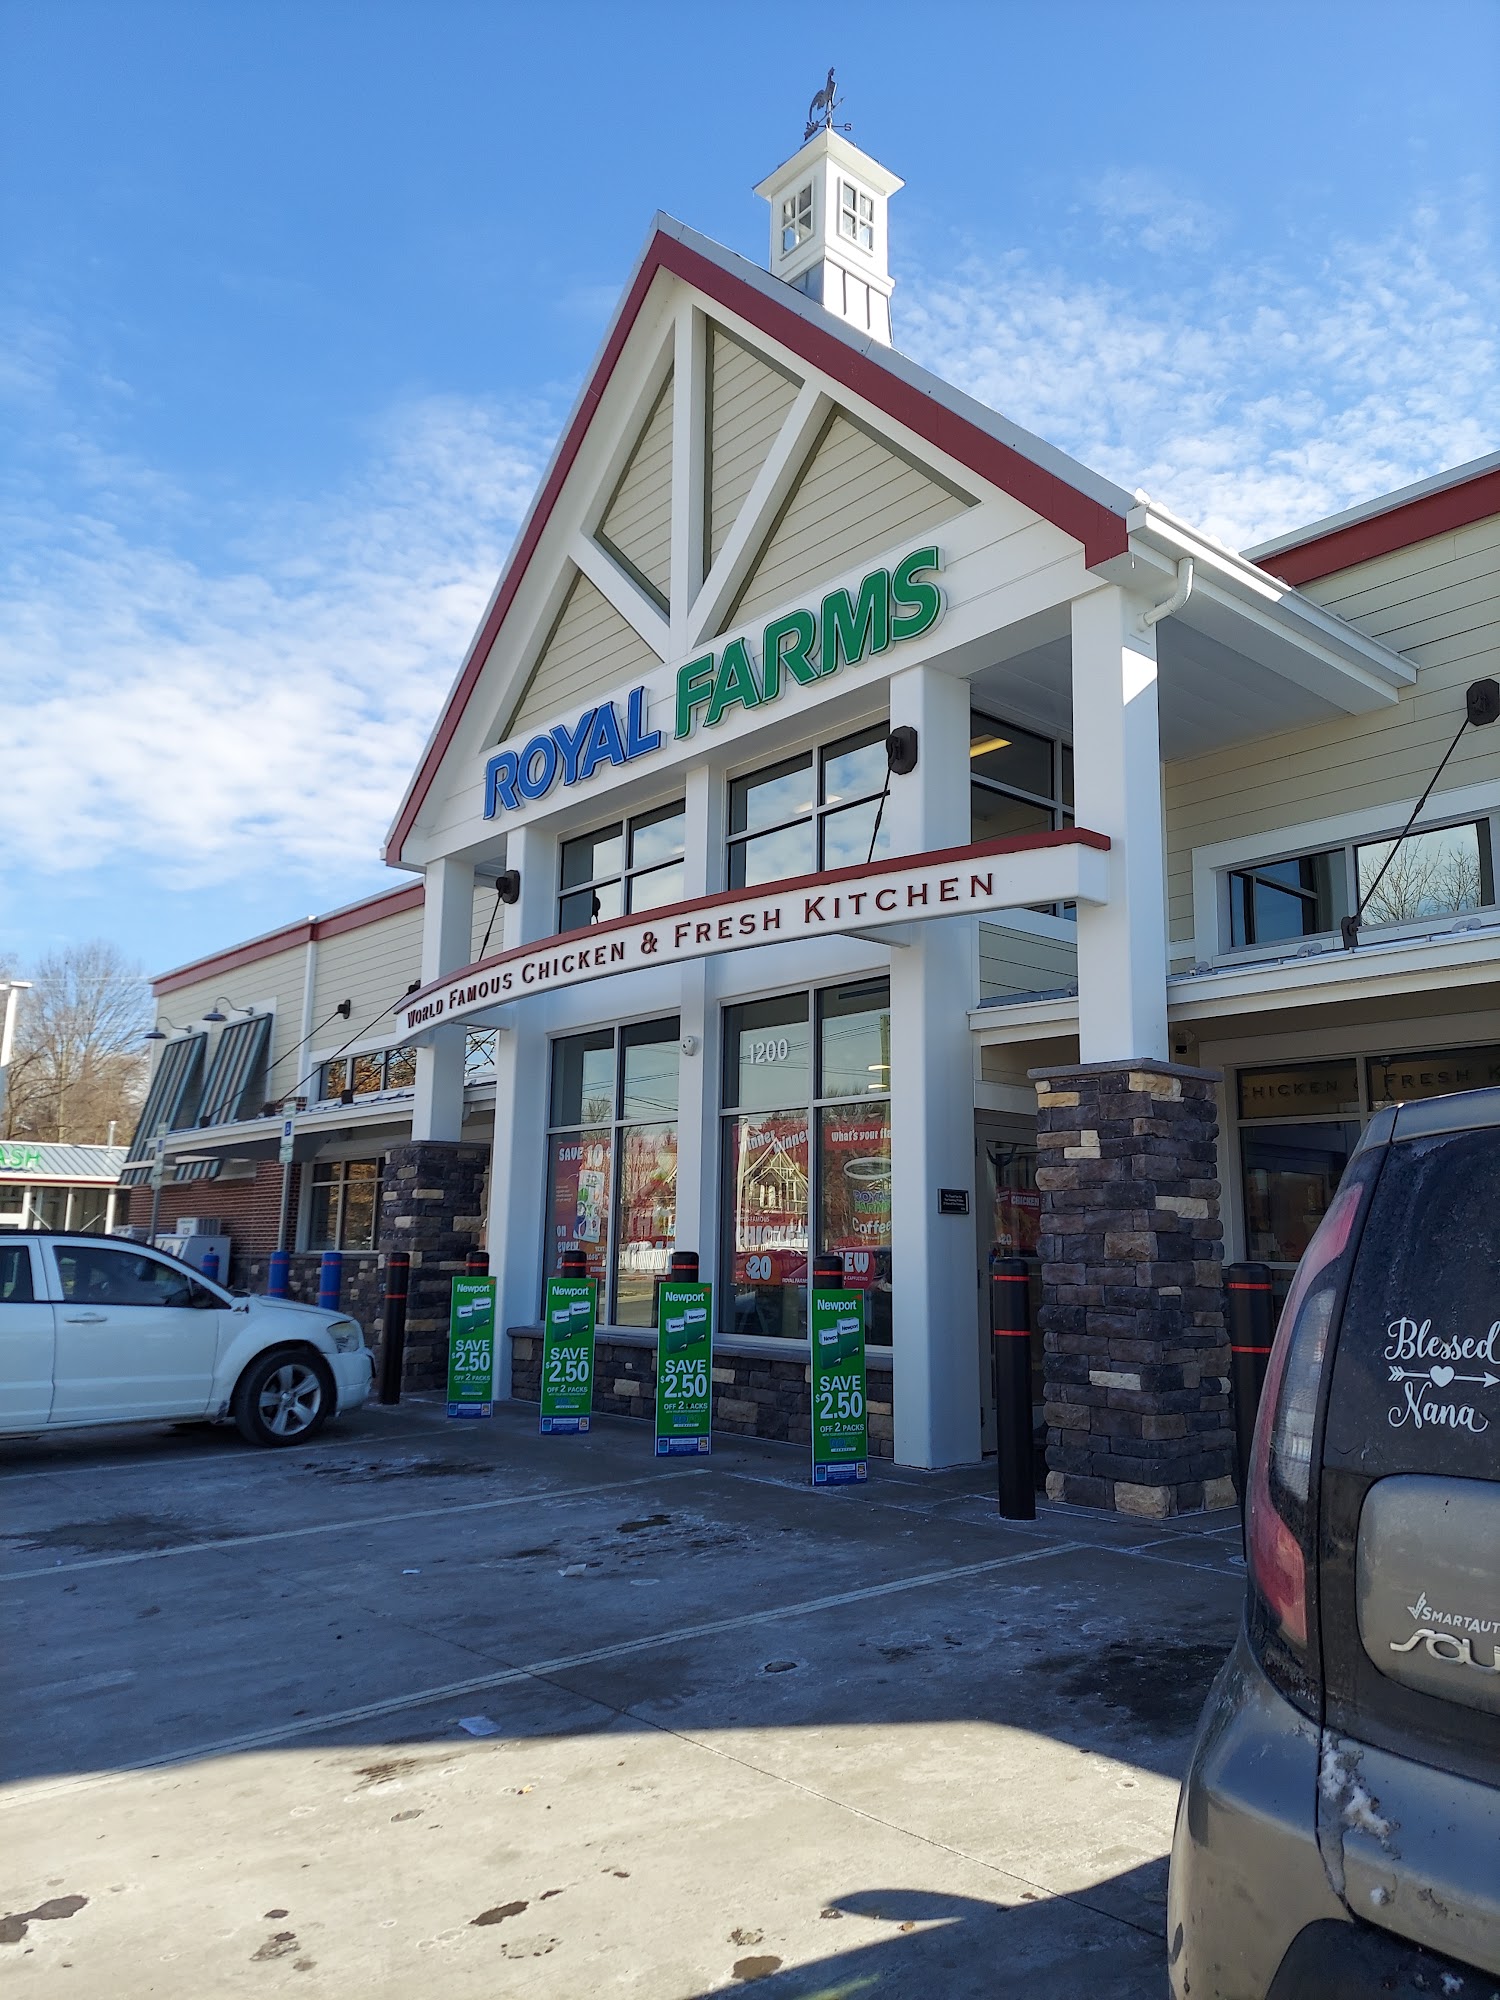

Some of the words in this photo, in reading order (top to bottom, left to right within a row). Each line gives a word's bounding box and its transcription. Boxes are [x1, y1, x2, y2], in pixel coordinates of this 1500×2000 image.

[483, 685, 664, 821] ROYAL
[674, 545, 944, 741] FARMS
[640, 931, 658, 954] &
[748, 1038, 788, 1064] 1200
[859, 1129, 879, 1140] your
[559, 1146, 584, 1161] SAVE
[853, 1217, 891, 1234] Coffee
[456, 1283, 490, 1294] Newport
[552, 1285, 589, 1297] Newport
[665, 1291, 705, 1304] Newport
[817, 1299, 857, 1312] Newport
[455, 1339, 490, 1351] SAVE
[1384, 1316, 1500, 1365] Blessed
[452, 1351, 490, 1372] $2.50
[550, 1347, 589, 1361] SAVE
[545, 1360, 589, 1383] $2.50
[665, 1359, 707, 1374] SAVE
[465, 1373, 470, 1381] 2
[820, 1375, 861, 1391] SAVE
[560, 1384, 566, 1393] 2
[660, 1374, 707, 1398] $2.50
[678, 1400, 685, 1410] 2
[815, 1391, 863, 1420] $2.50
[1388, 1381, 1489, 1432] Nana
[820, 1425, 833, 1433] OFF
[834, 1422, 841, 1432] 2
[842, 1423, 865, 1431] PACKS
